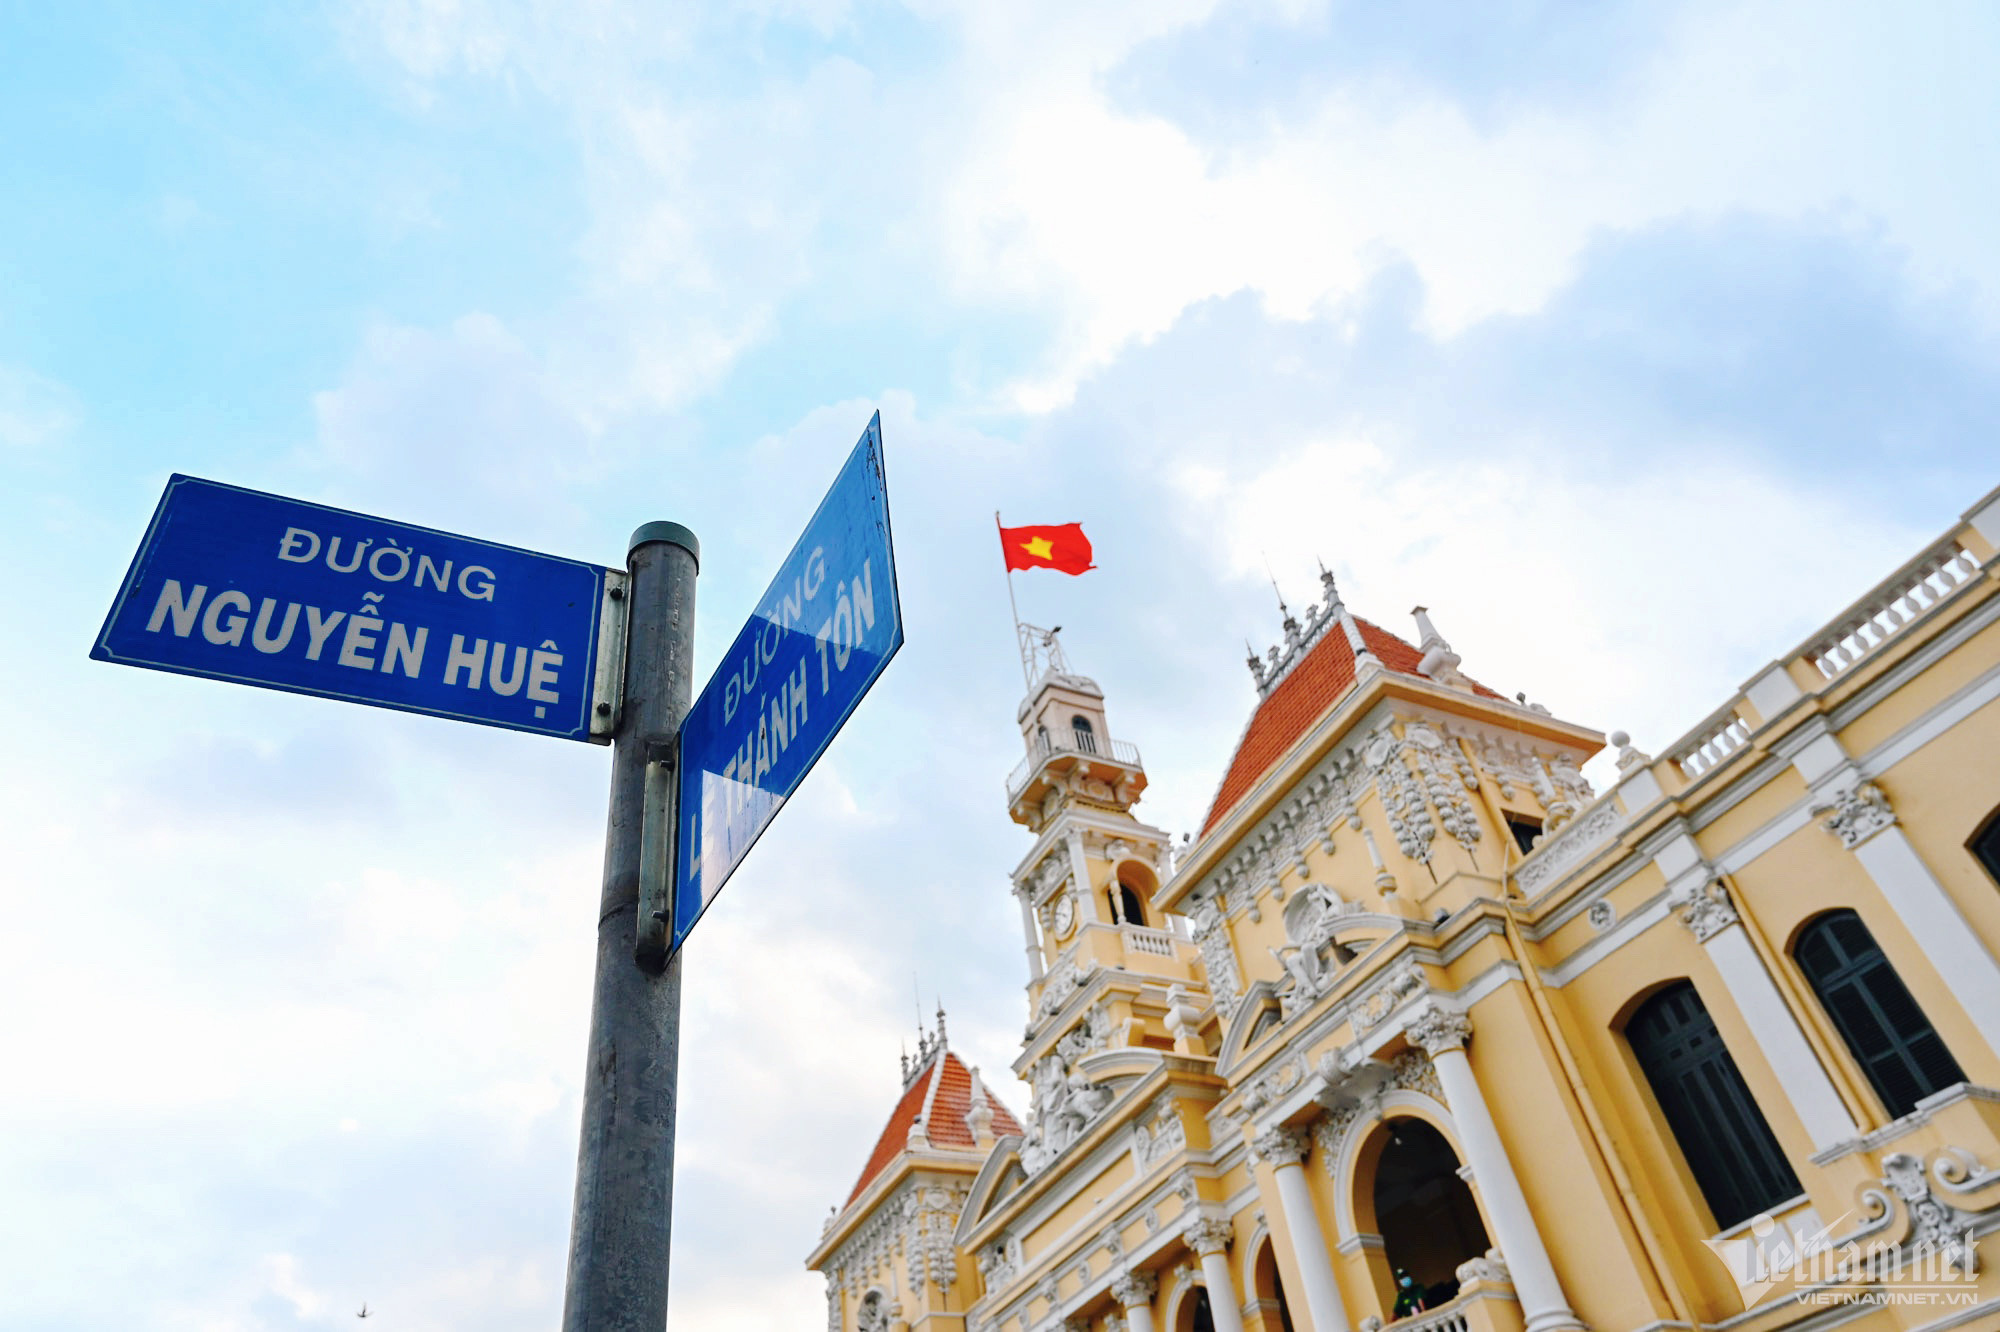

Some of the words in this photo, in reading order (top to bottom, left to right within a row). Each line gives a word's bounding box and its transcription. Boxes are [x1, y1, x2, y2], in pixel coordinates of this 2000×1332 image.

[278, 527, 497, 602] ĐƯỜNG
[723, 546, 825, 727] ĐƯỜNG
[145, 579, 430, 679] NGUYỄN
[442, 634, 565, 719] HUỆ
[722, 691, 808, 827] THÁNH
[815, 556, 875, 698] TÔN
